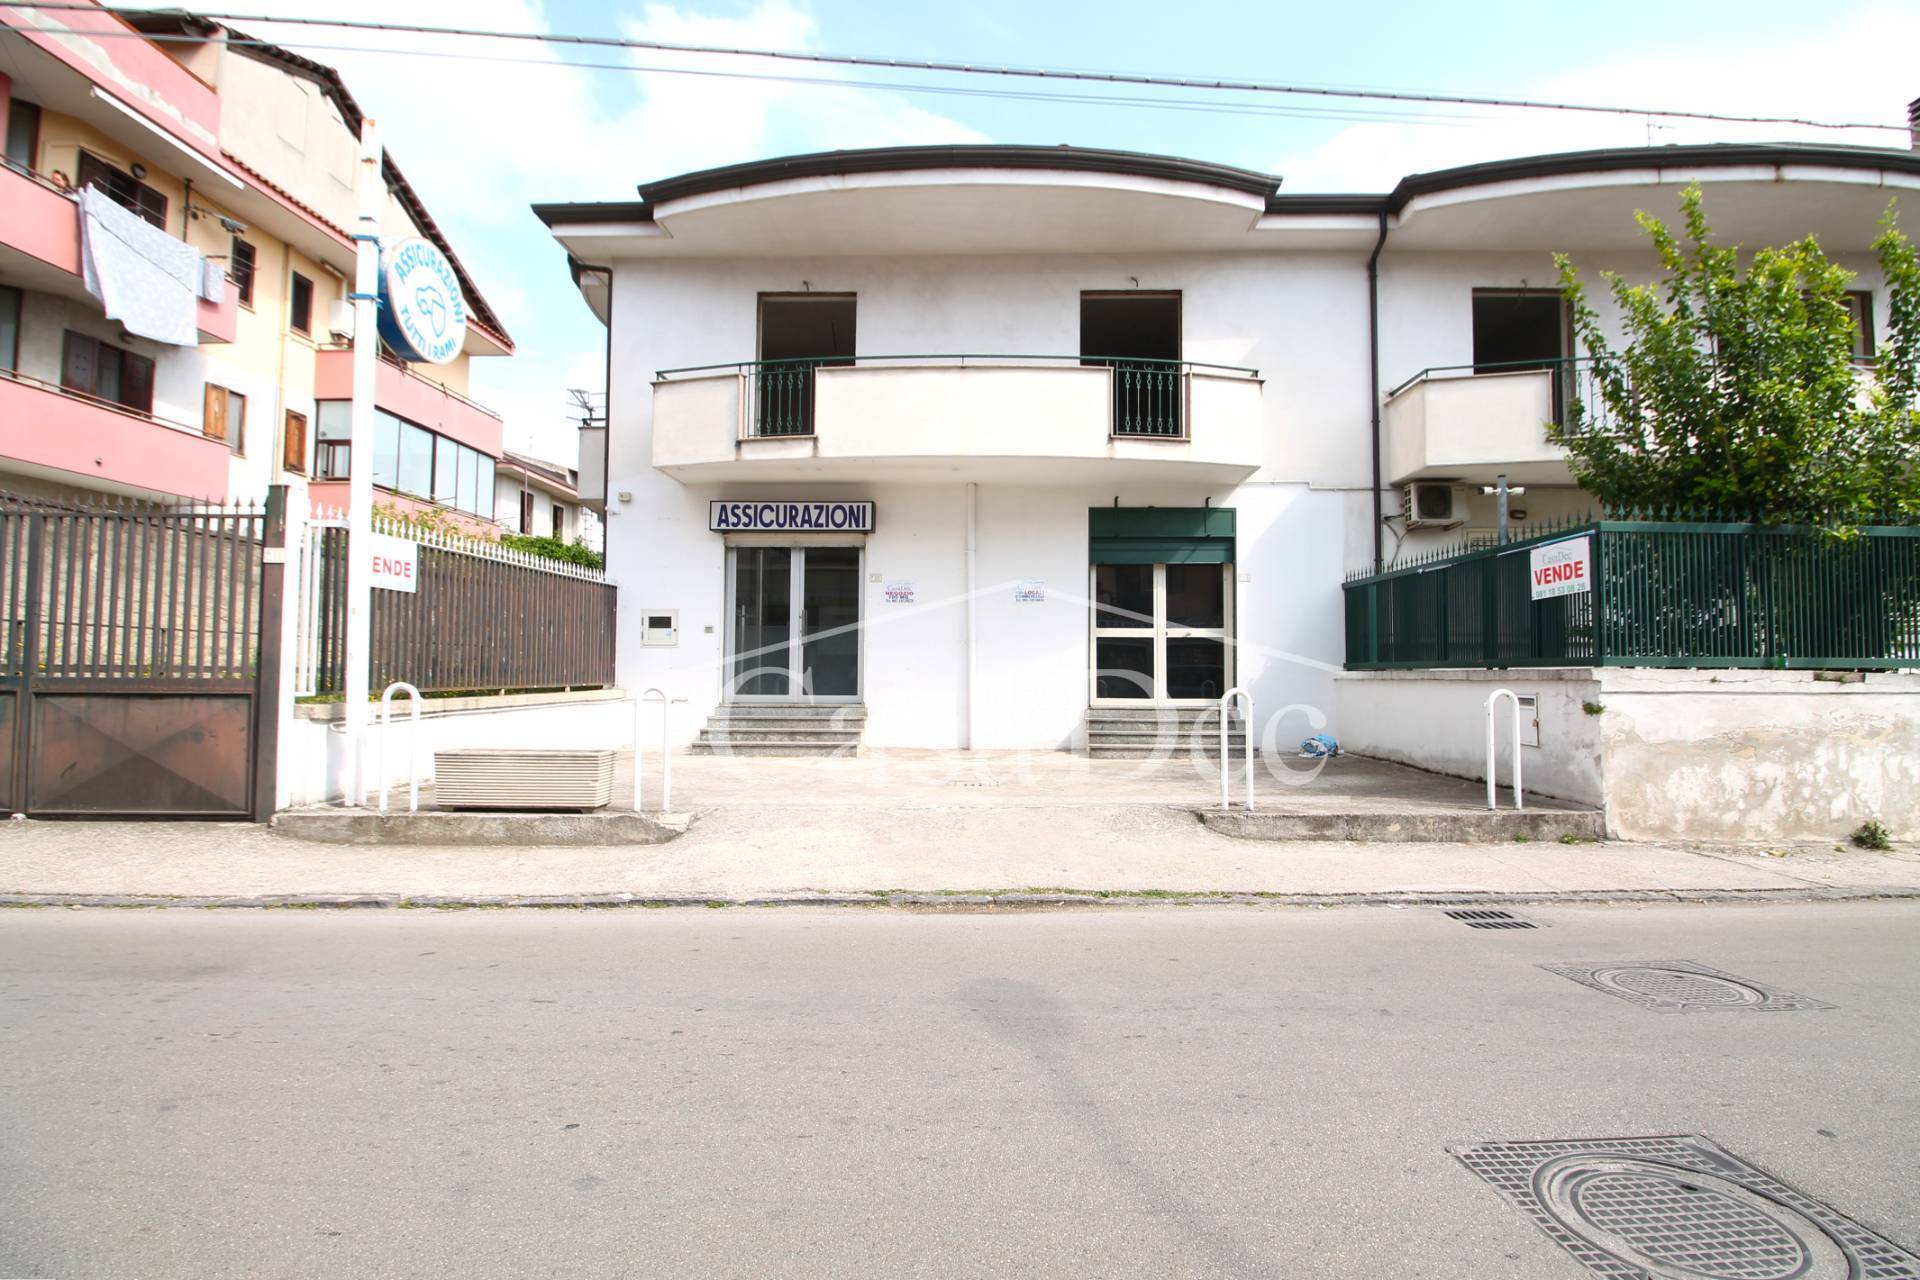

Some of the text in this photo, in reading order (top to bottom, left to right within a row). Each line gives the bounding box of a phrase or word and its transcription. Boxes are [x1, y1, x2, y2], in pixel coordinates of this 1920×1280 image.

[394, 243, 464, 323] ASSICURAZIONI
[400, 304, 426, 352] TUTTI
[432, 338, 457, 360] RAMI
[717, 504, 866, 528] ASSICURAZIONI
[372, 556, 411, 578] ENDE
[1534, 560, 1584, 586] VENDE
